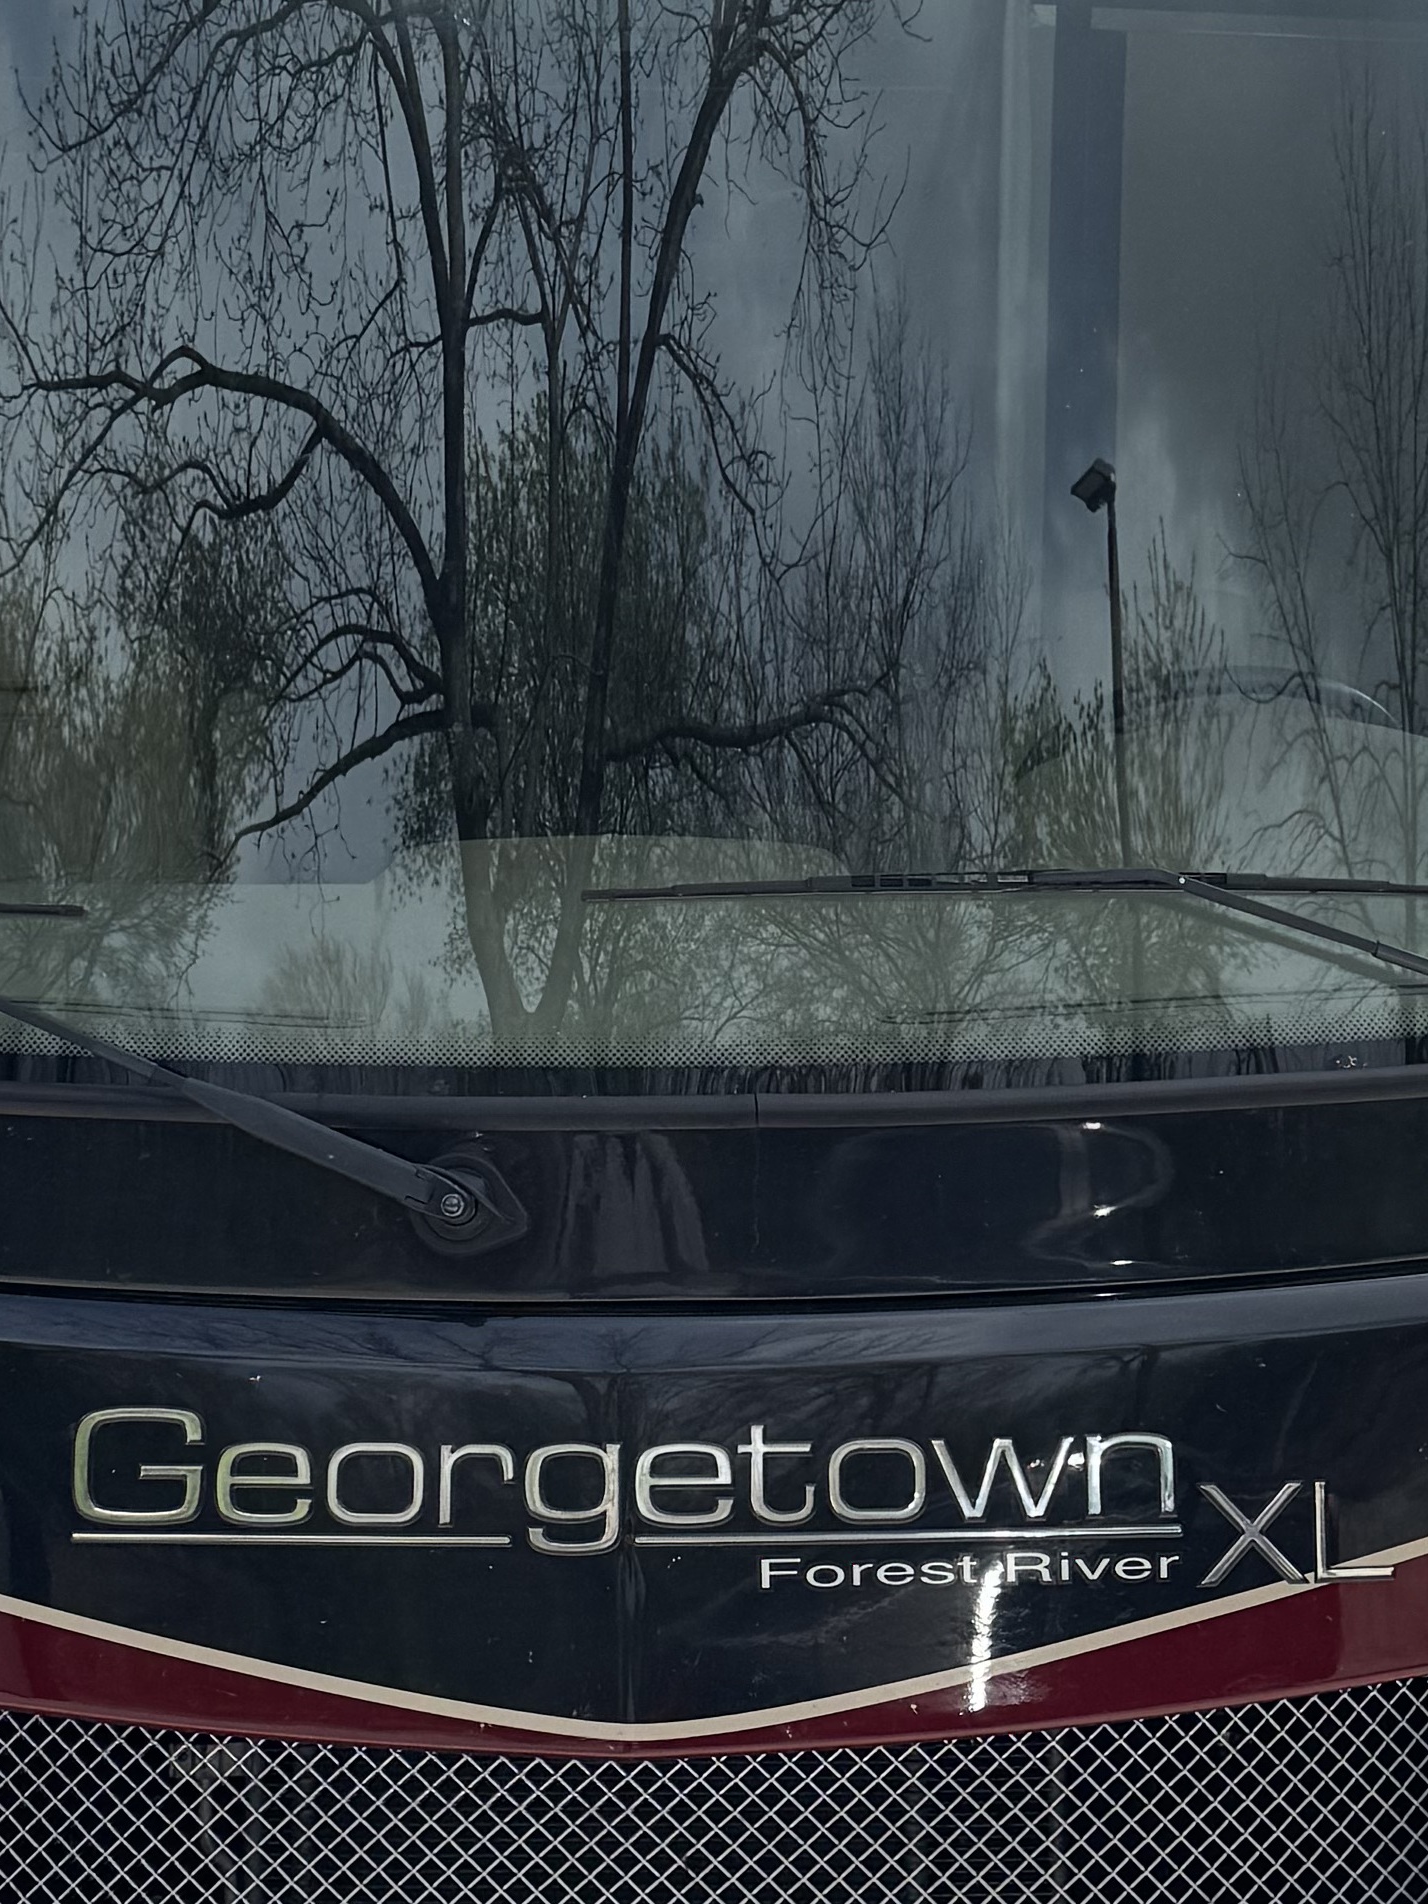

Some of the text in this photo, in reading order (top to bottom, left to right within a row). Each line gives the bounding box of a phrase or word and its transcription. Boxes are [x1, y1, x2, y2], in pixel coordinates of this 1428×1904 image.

[73, 1407, 1177, 1554] Georgetown
[1197, 1480, 1395, 1586] XL
[760, 1551, 1179, 1589] Forest River
